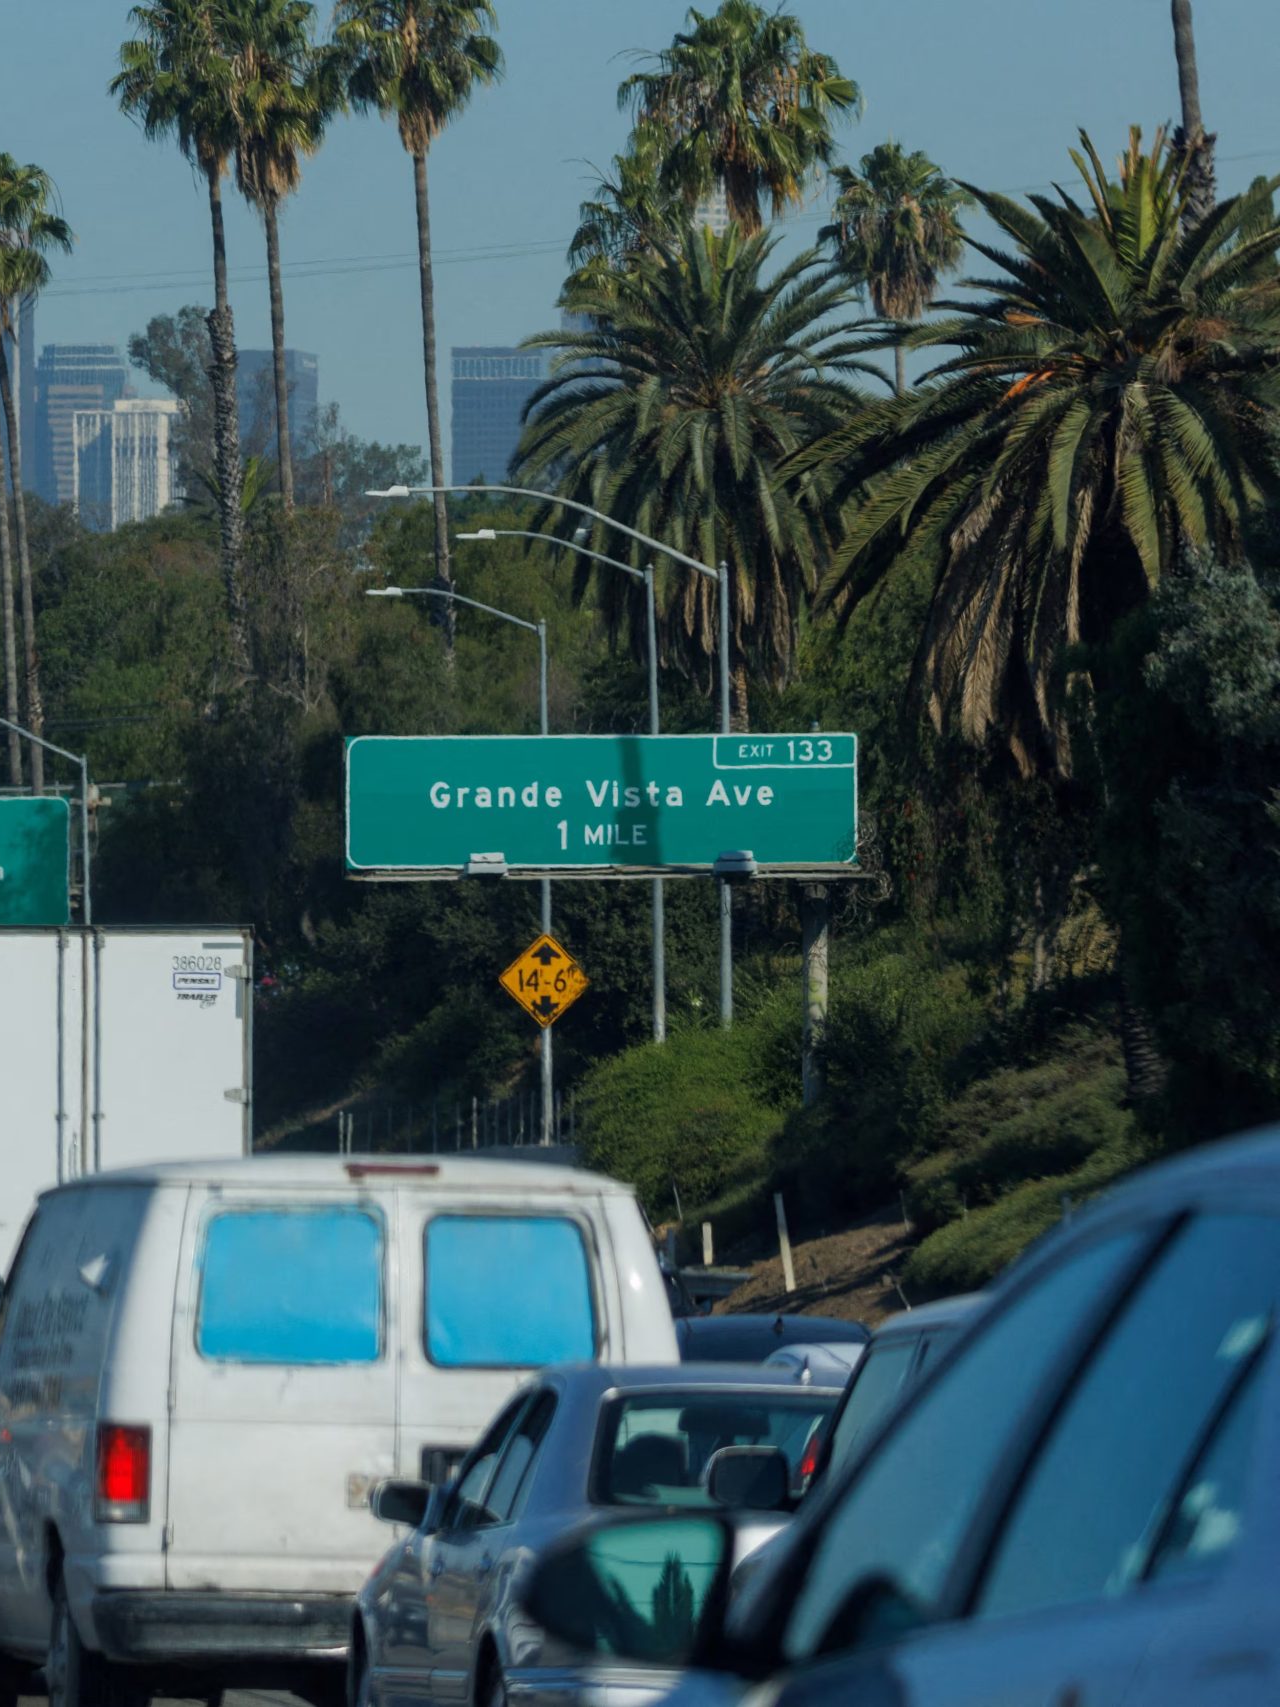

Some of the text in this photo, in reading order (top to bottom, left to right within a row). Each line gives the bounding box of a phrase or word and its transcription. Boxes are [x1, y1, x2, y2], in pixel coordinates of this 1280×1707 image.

[738, 740, 833, 762] EXIT 133
[429, 779, 775, 809] Grande Vista Ave
[556, 819, 649, 851] 1 MILE
[173, 956, 221, 971] 386028
